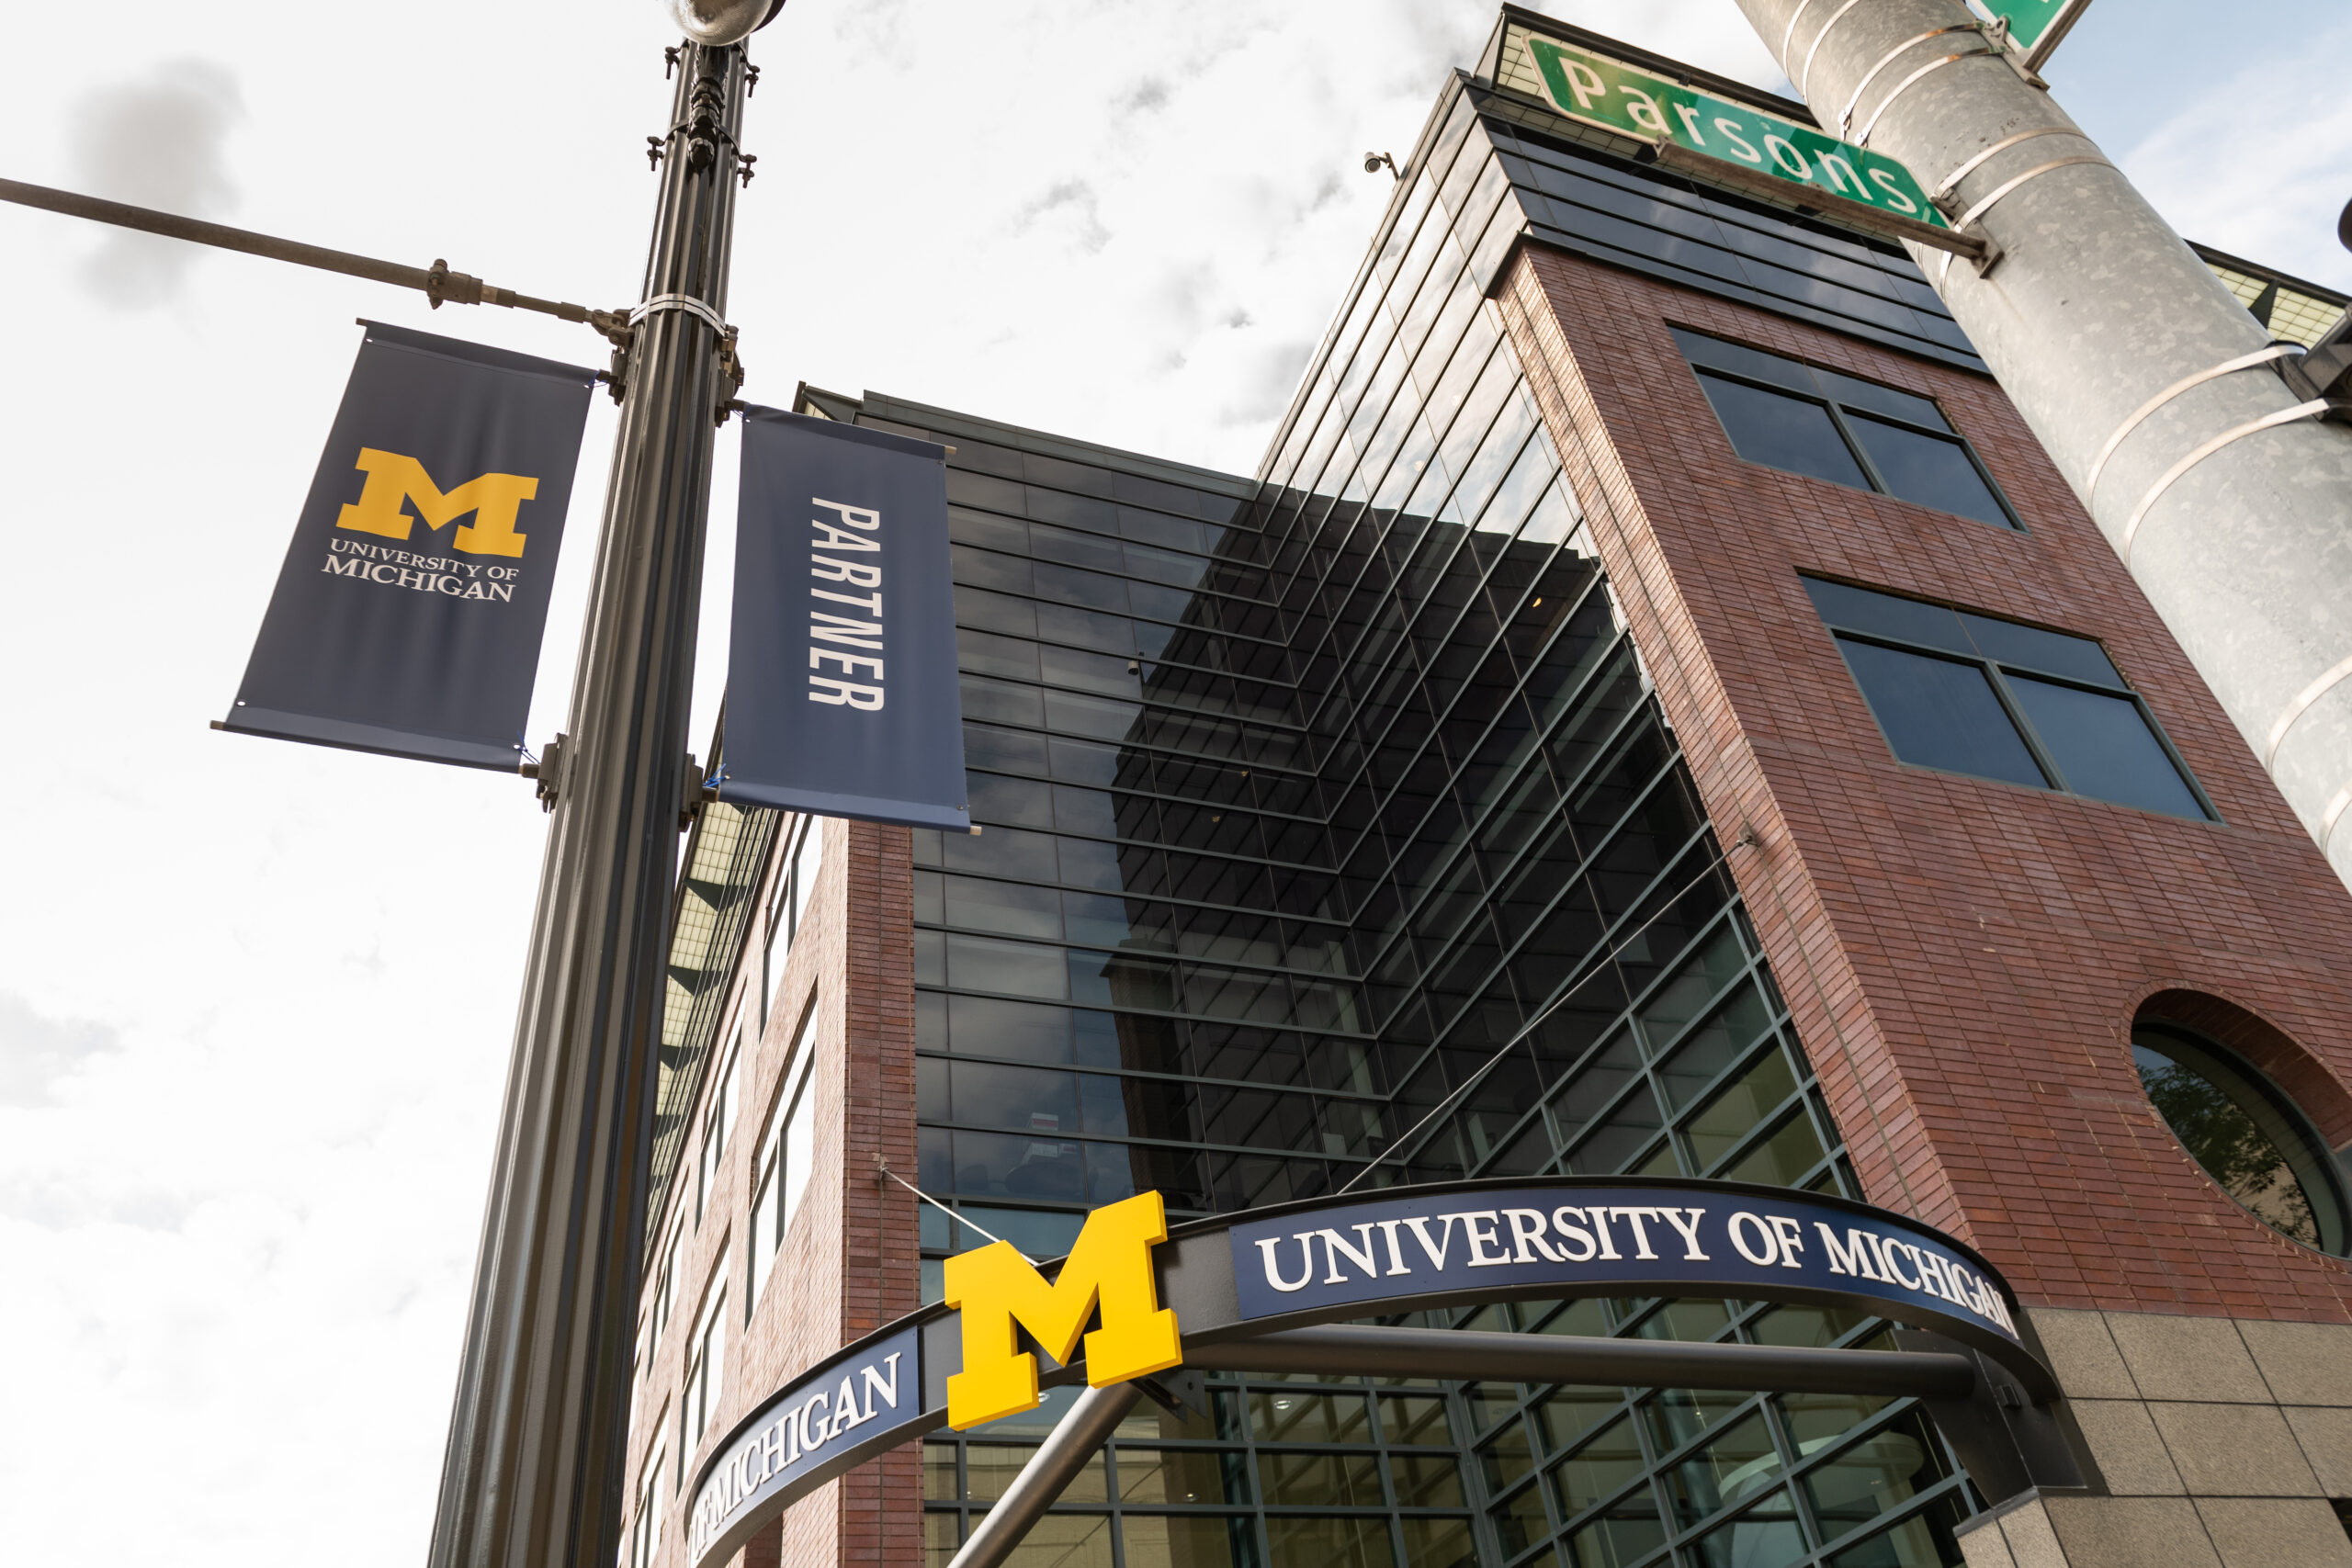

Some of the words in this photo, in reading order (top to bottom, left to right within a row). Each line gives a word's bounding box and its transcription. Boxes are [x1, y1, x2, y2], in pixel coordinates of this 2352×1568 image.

[1557, 56, 1916, 215] Parsons
[330, 537, 482, 578] UNIVERSITY
[487, 566, 520, 581] OF
[335, 446, 539, 558] M
[321, 554, 516, 603] MICHIGAN
[808, 496, 885, 713] PARTNER
[944, 1190, 1183, 1432] M
[1254, 1205, 1711, 1293] UNIVERSITY
[1728, 1211, 1805, 1269] OF
[1813, 1221, 2019, 1340] MICHIGAN
[713, 1351, 902, 1531] MICHIGAN
